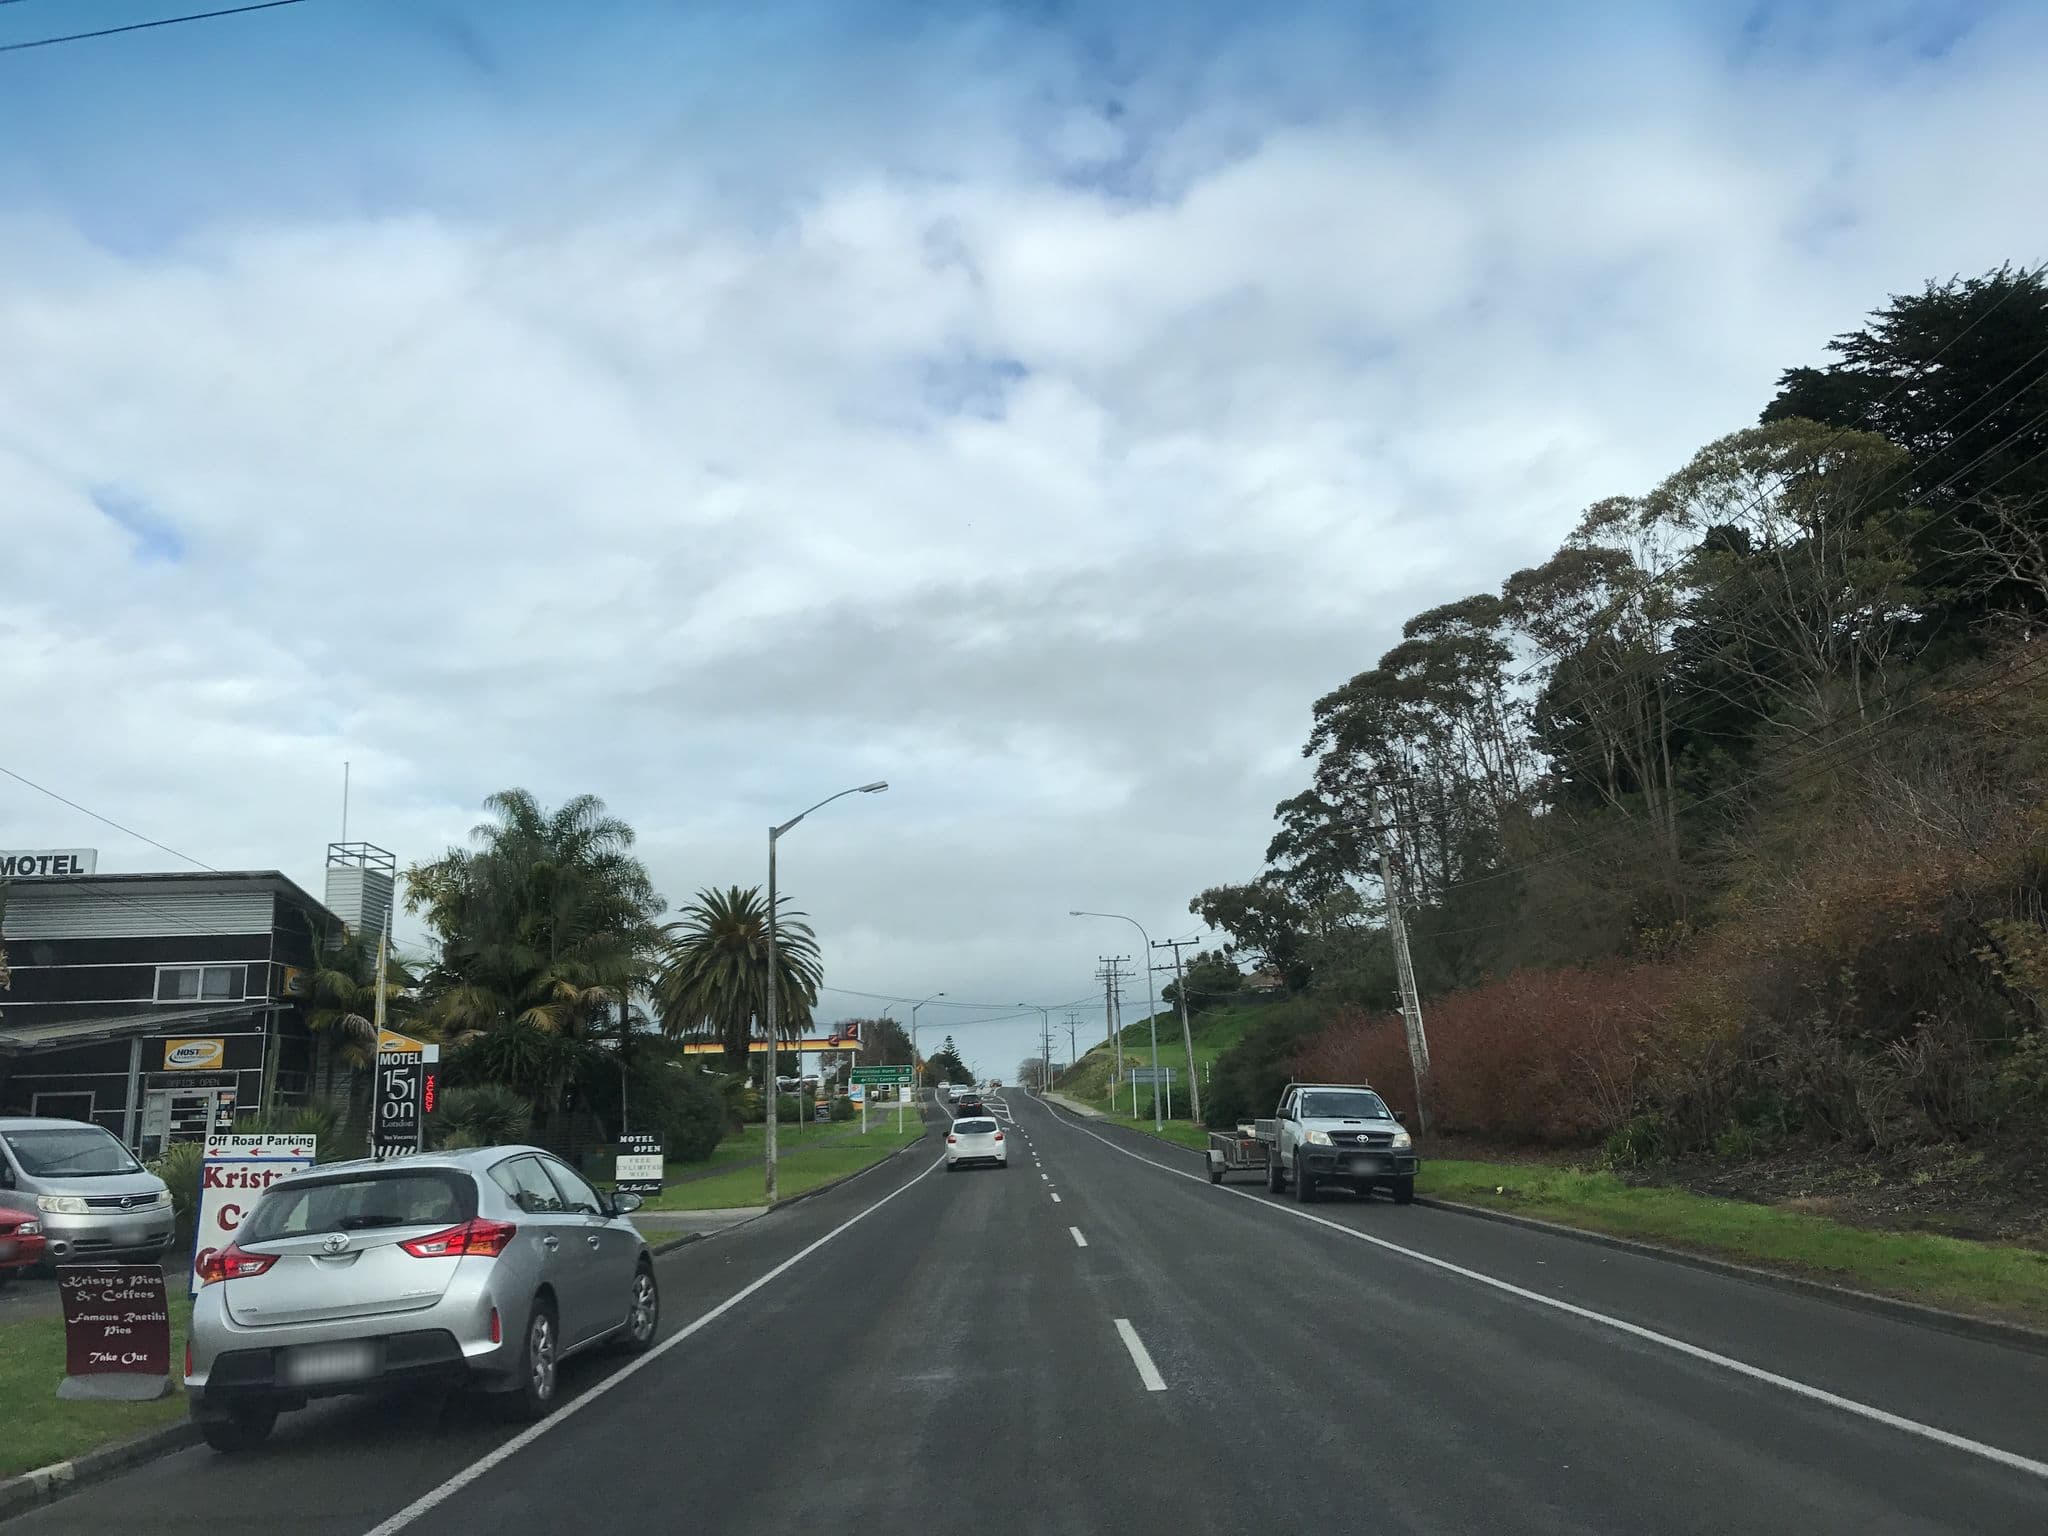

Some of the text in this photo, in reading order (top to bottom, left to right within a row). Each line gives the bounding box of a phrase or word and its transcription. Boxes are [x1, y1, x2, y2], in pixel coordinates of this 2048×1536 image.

[0, 855, 84, 875] MOTEL
[176, 1048, 199, 1056] HOST
[380, 1053, 422, 1065] MOTEL
[383, 1068, 415, 1100] 151
[382, 1101, 414, 1119] on
[208, 1136, 314, 1147] Off Road Parking
[620, 1135, 654, 1143] MOTEL
[62, 1275, 162, 1287] Kristy's Pies
[102, 1290, 155, 1302] Coffees
[69, 1313, 119, 1323] Famous
[104, 1326, 132, 1337] Pies
[90, 1352, 148, 1364] Take Out
